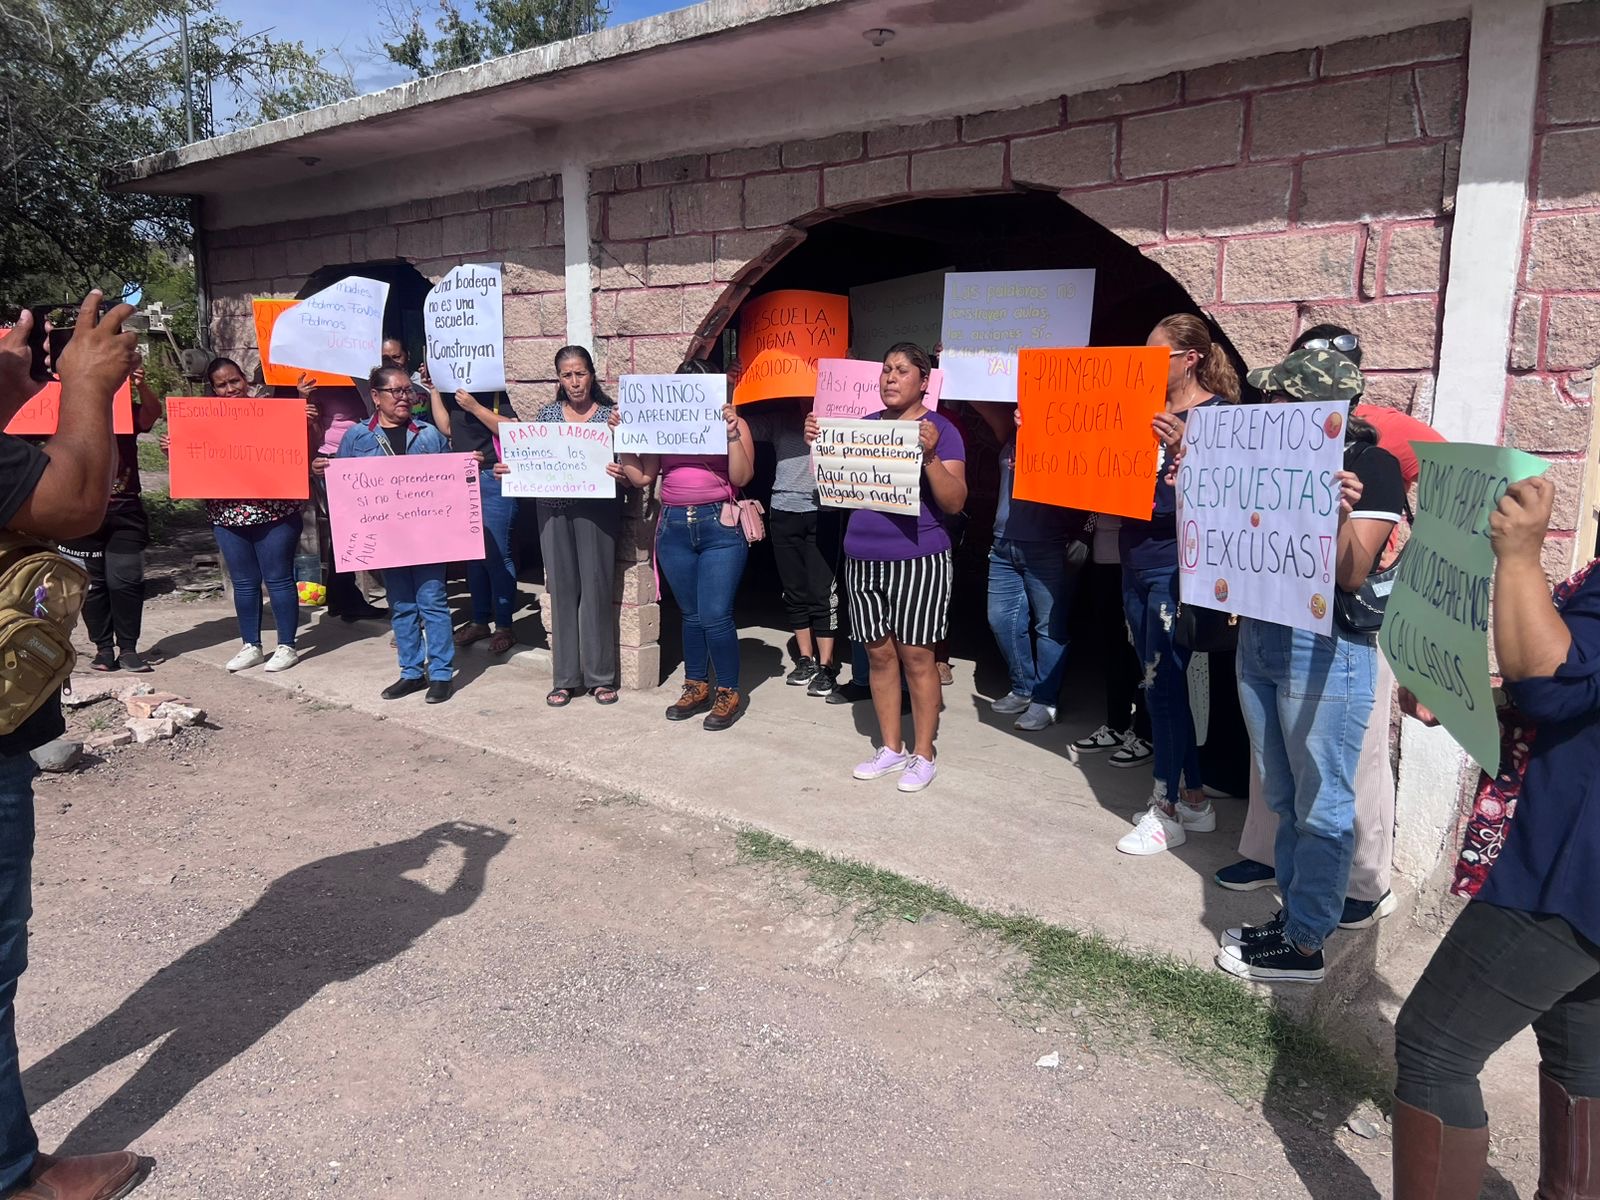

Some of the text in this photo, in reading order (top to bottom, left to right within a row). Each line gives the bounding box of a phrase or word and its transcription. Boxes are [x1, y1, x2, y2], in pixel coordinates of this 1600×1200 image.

[434, 269, 497, 297] Una bodega
[429, 298, 475, 313] no es una
[435, 311, 479, 329] escuela.
[756, 326, 837, 354] DIGNA YA"
[449, 361, 472, 384] Ya!
[651, 380, 706, 404] NIÑOS
[637, 408, 700, 423] APRENDEN
[1046, 401, 1123, 436] ESCUELA
[509, 424, 610, 448] PARO LABORAL
[621, 432, 649, 445] UNA
[832, 429, 845, 444] la
[851, 428, 904, 447] Escuela
[1185, 407, 1325, 455] QUEREMOS
[503, 446, 554, 460] Exigimos
[816, 444, 924, 464] que prometieron?
[1021, 443, 1059, 475] LUEGO
[1067, 450, 1089, 477] LAS
[390, 472, 456, 486] aprenderan
[817, 463, 892, 489] Aquí no ha
[375, 494, 389, 505] no
[396, 489, 434, 501] tienen
[819, 484, 865, 503] llegado
[1182, 465, 1333, 516] RESPUESTAS
[396, 504, 453, 521] sentarse?
[57, 544, 91, 558] AGAINST
[341, 531, 359, 565] FALTA
[355, 532, 378, 565] AULA
[1387, 611, 1475, 712] CALLADOS
